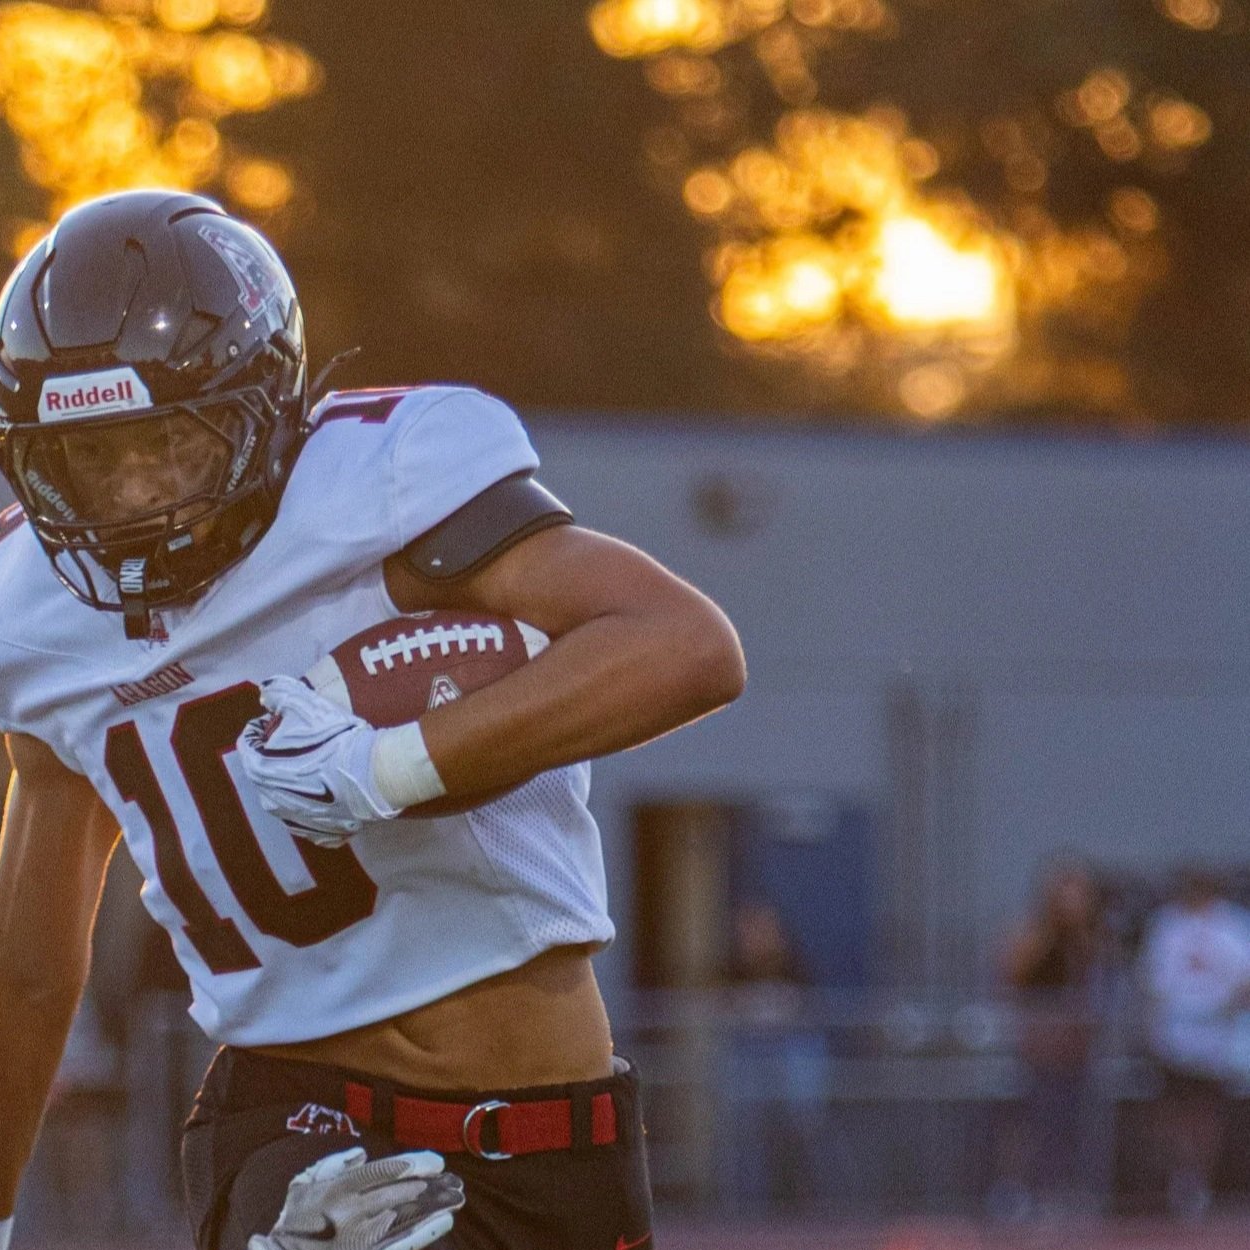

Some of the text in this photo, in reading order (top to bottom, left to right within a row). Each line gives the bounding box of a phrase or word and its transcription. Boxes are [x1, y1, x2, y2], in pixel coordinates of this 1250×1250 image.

[45, 380, 134, 412] Riddell
[109, 661, 196, 707] ARAGON
[103, 680, 379, 977] 10
